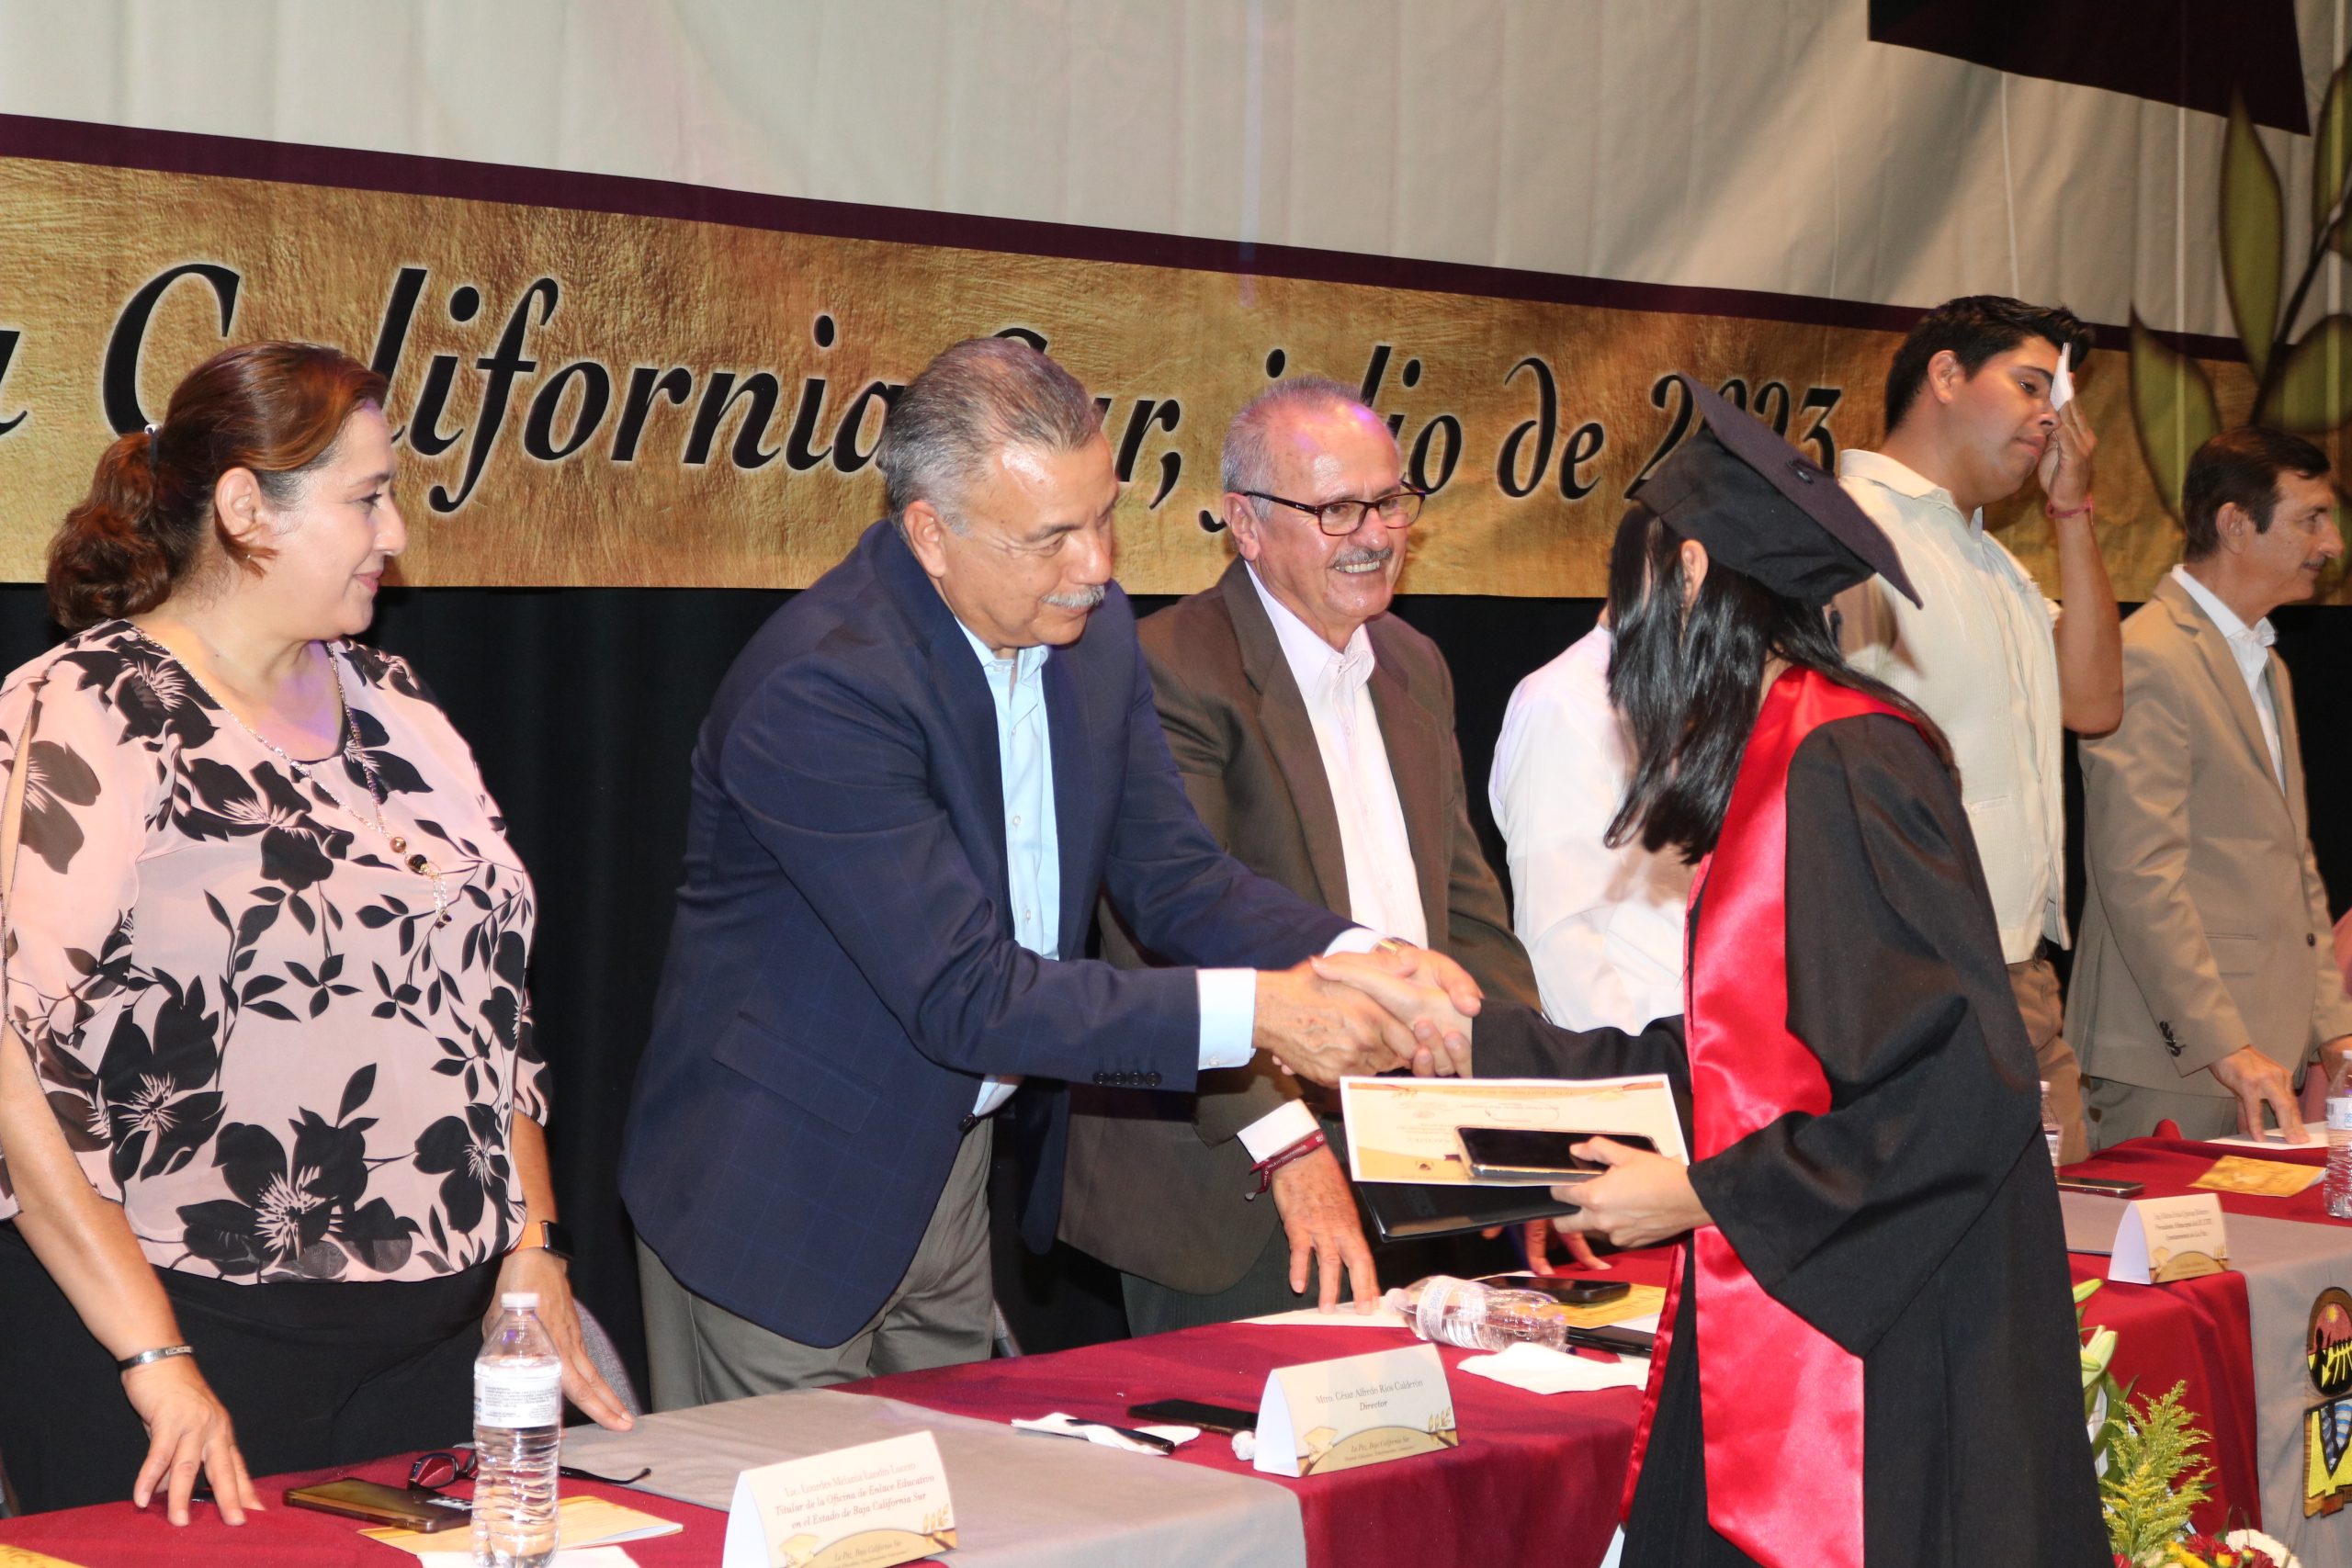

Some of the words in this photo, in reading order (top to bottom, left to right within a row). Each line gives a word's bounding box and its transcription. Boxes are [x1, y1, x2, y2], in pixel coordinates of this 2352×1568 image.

[103, 264, 905, 513] Clifornia
[1498, 356, 1601, 499] de
[1355, 1388, 1378, 1397] Alfredo
[1360, 1400, 1387, 1411] Director
[775, 1505, 803, 1515] Titular
[806, 1499, 815, 1509] de
[817, 1496, 825, 1506] la
[827, 1493, 855, 1505] Oficina
[858, 1488, 866, 1497] de
[869, 1483, 894, 1495] Enlace
[897, 1475, 934, 1489] Educativo
[792, 1521, 801, 1529] en
[804, 1517, 810, 1526] el
[813, 1508, 840, 1524] Estado
[842, 1507, 851, 1517] de
[854, 1503, 870, 1516] Baja
[873, 1496, 910, 1511] California
[913, 1492, 926, 1501] Sur
